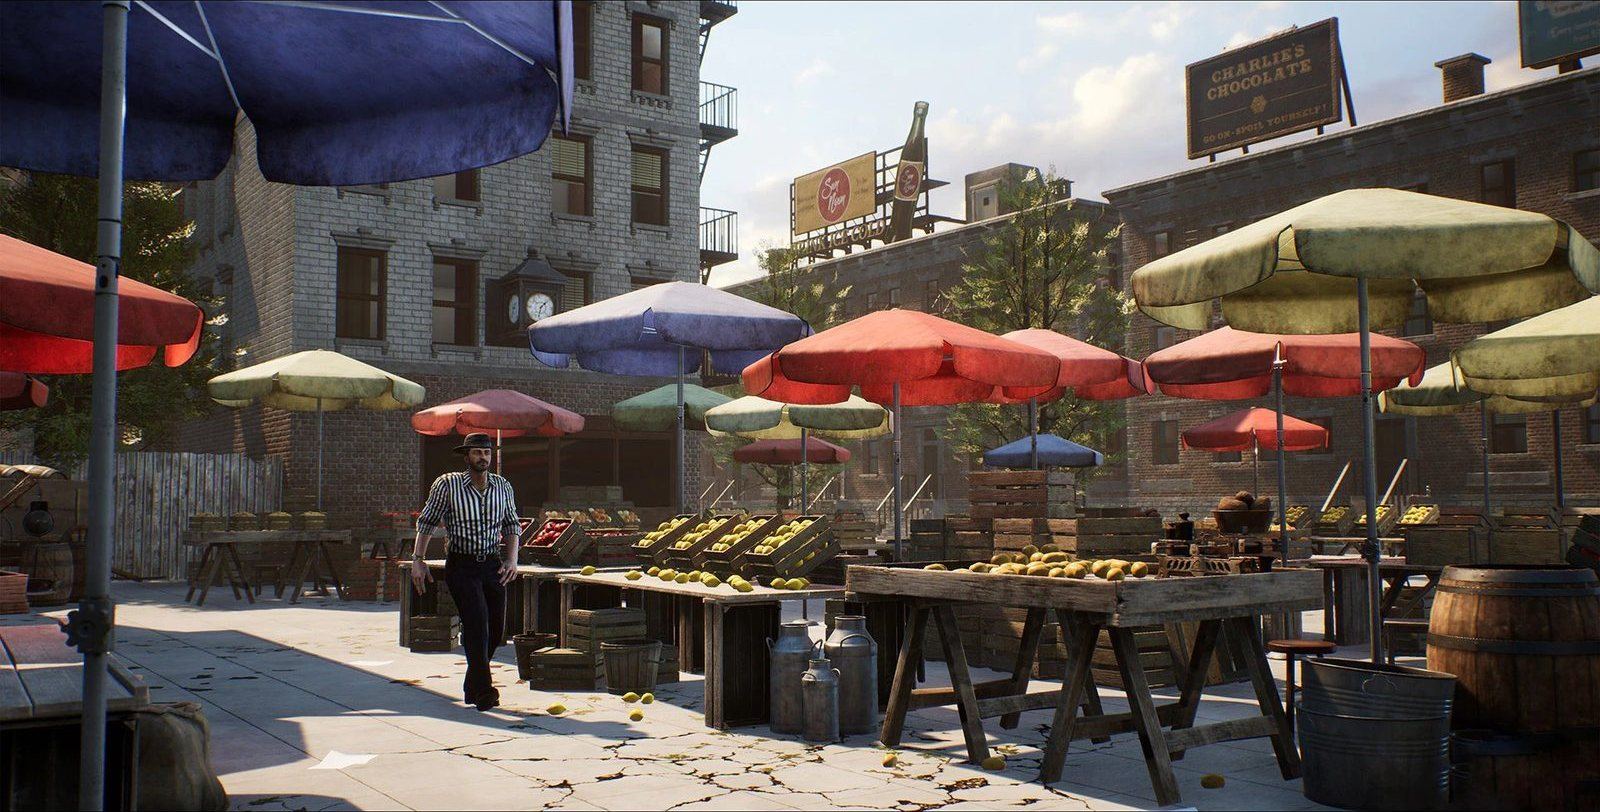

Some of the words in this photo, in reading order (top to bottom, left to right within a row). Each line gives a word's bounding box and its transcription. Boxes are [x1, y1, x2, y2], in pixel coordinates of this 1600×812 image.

[1207, 59, 1312, 100] CHOCOLATE
[1212, 44, 1305, 83] CHARLIE'S
[1203, 135, 1216, 143] GO
[828, 228, 849, 248] ICE
[851, 219, 886, 242] COLD
